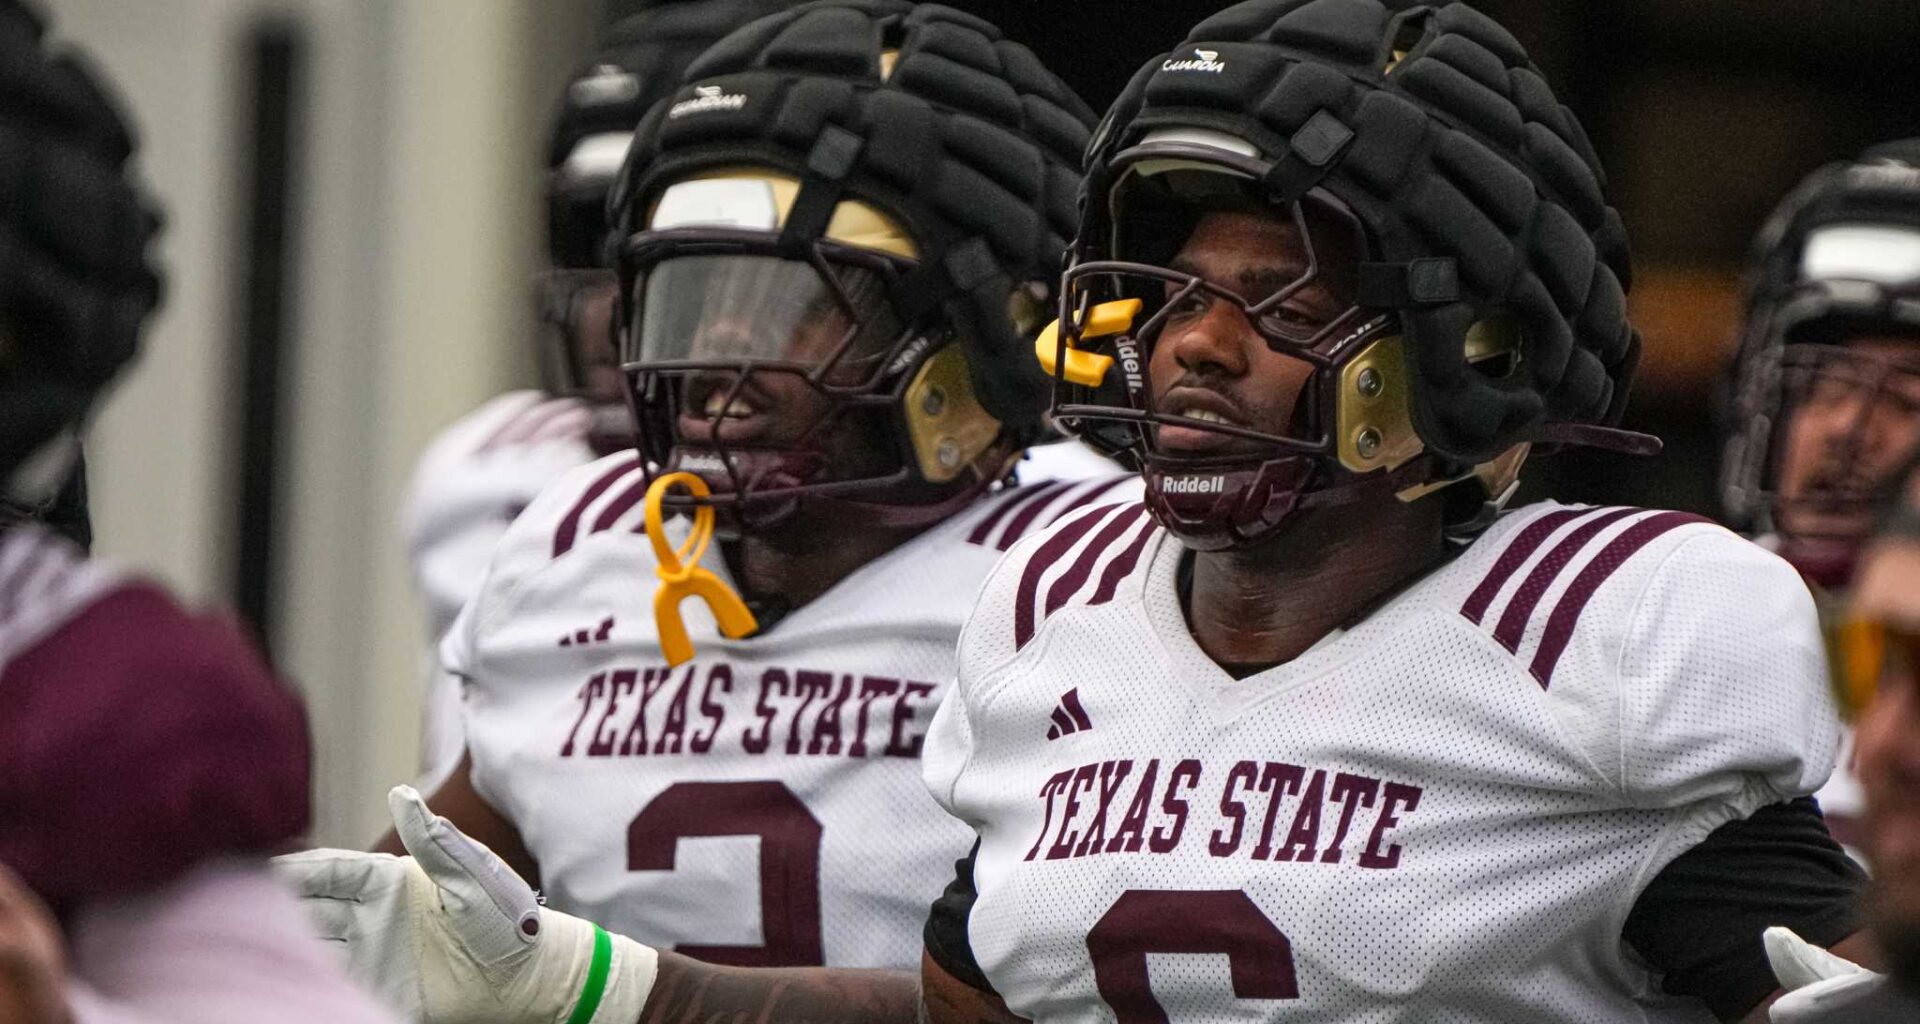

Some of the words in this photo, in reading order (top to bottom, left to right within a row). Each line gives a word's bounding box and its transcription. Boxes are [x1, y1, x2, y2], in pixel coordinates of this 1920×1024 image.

[1162, 475, 1225, 493] Riddell
[559, 663, 733, 757] TEXAS
[742, 667, 938, 759] STATE
[1023, 758, 1203, 862] TEXAS
[1208, 760, 1423, 869] STATE
